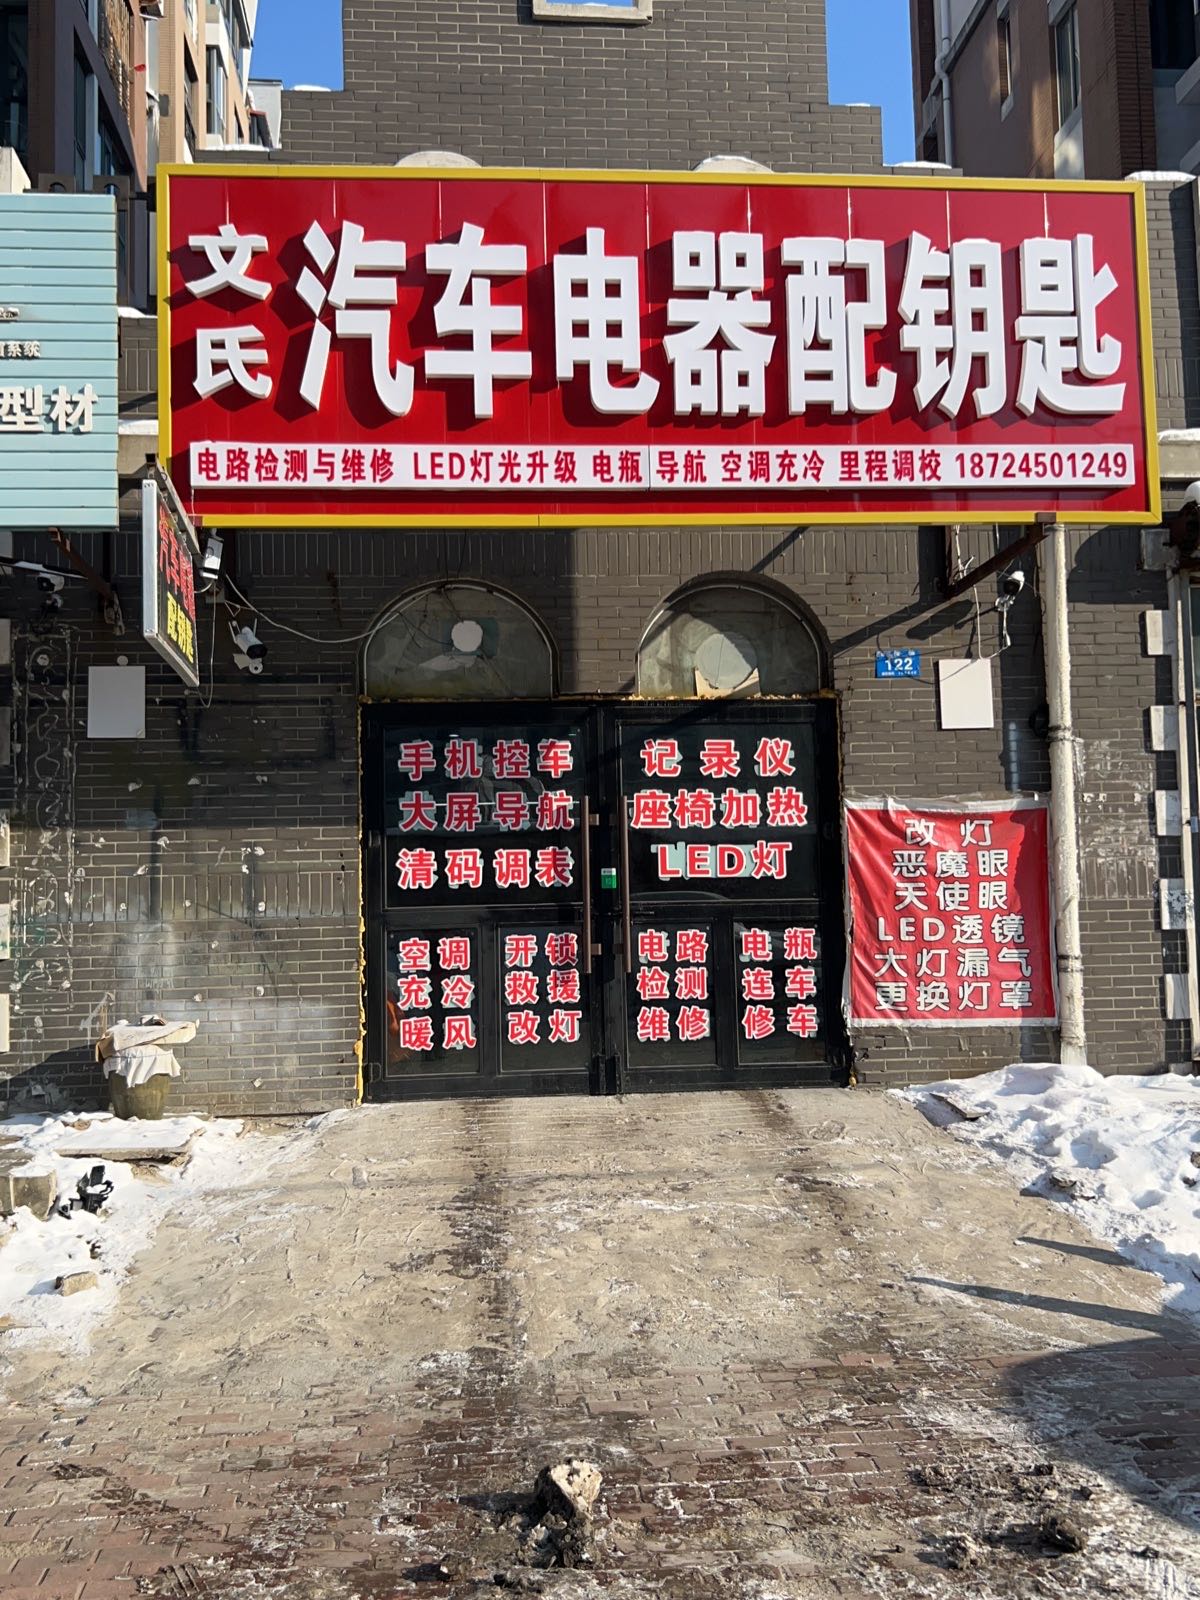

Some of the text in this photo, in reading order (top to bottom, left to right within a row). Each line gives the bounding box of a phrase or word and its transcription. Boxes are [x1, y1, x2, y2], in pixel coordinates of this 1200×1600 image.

[185, 223, 273, 400] 文民
[296, 219, 1126, 419] 汽车电器配钥匙
[0, 341, 41, 358] 系统
[198, 447, 1127, 484] 电路检测与维修 LED灯光升级 电瓶 导航 空调充冷 里程调校 18724501249
[884, 657, 914, 671] 122
[398, 739, 573, 781] 手机控车
[641, 737, 796, 778] 记录仪
[400, 790, 573, 831] 大屏导航
[631, 787, 808, 829] 座椅加热
[396, 846, 573, 890] 清码调表
[657, 840, 793, 879] LED灯
[892, 849, 1009, 878] 恶魔眼
[894, 880, 1008, 911] 天使眼
[638, 929, 709, 963] 电路
[742, 928, 818, 961] 电瓶
[877, 913, 1025, 944] LED透镜
[399, 937, 471, 972] 空调
[505, 933, 578, 968] 开锁
[874, 946, 1032, 978] 大灯漏气
[397, 974, 475, 1010] 充冷
[505, 969, 580, 1005] 救援
[637, 966, 708, 1001] 检测
[743, 966, 817, 1001] 连车
[874, 980, 1033, 1011] 更换灯罩
[400, 1015, 477, 1052] 暖风
[508, 1009, 582, 1044] 改灯
[637, 1006, 710, 1042] 维修
[743, 1004, 818, 1040] 修车
